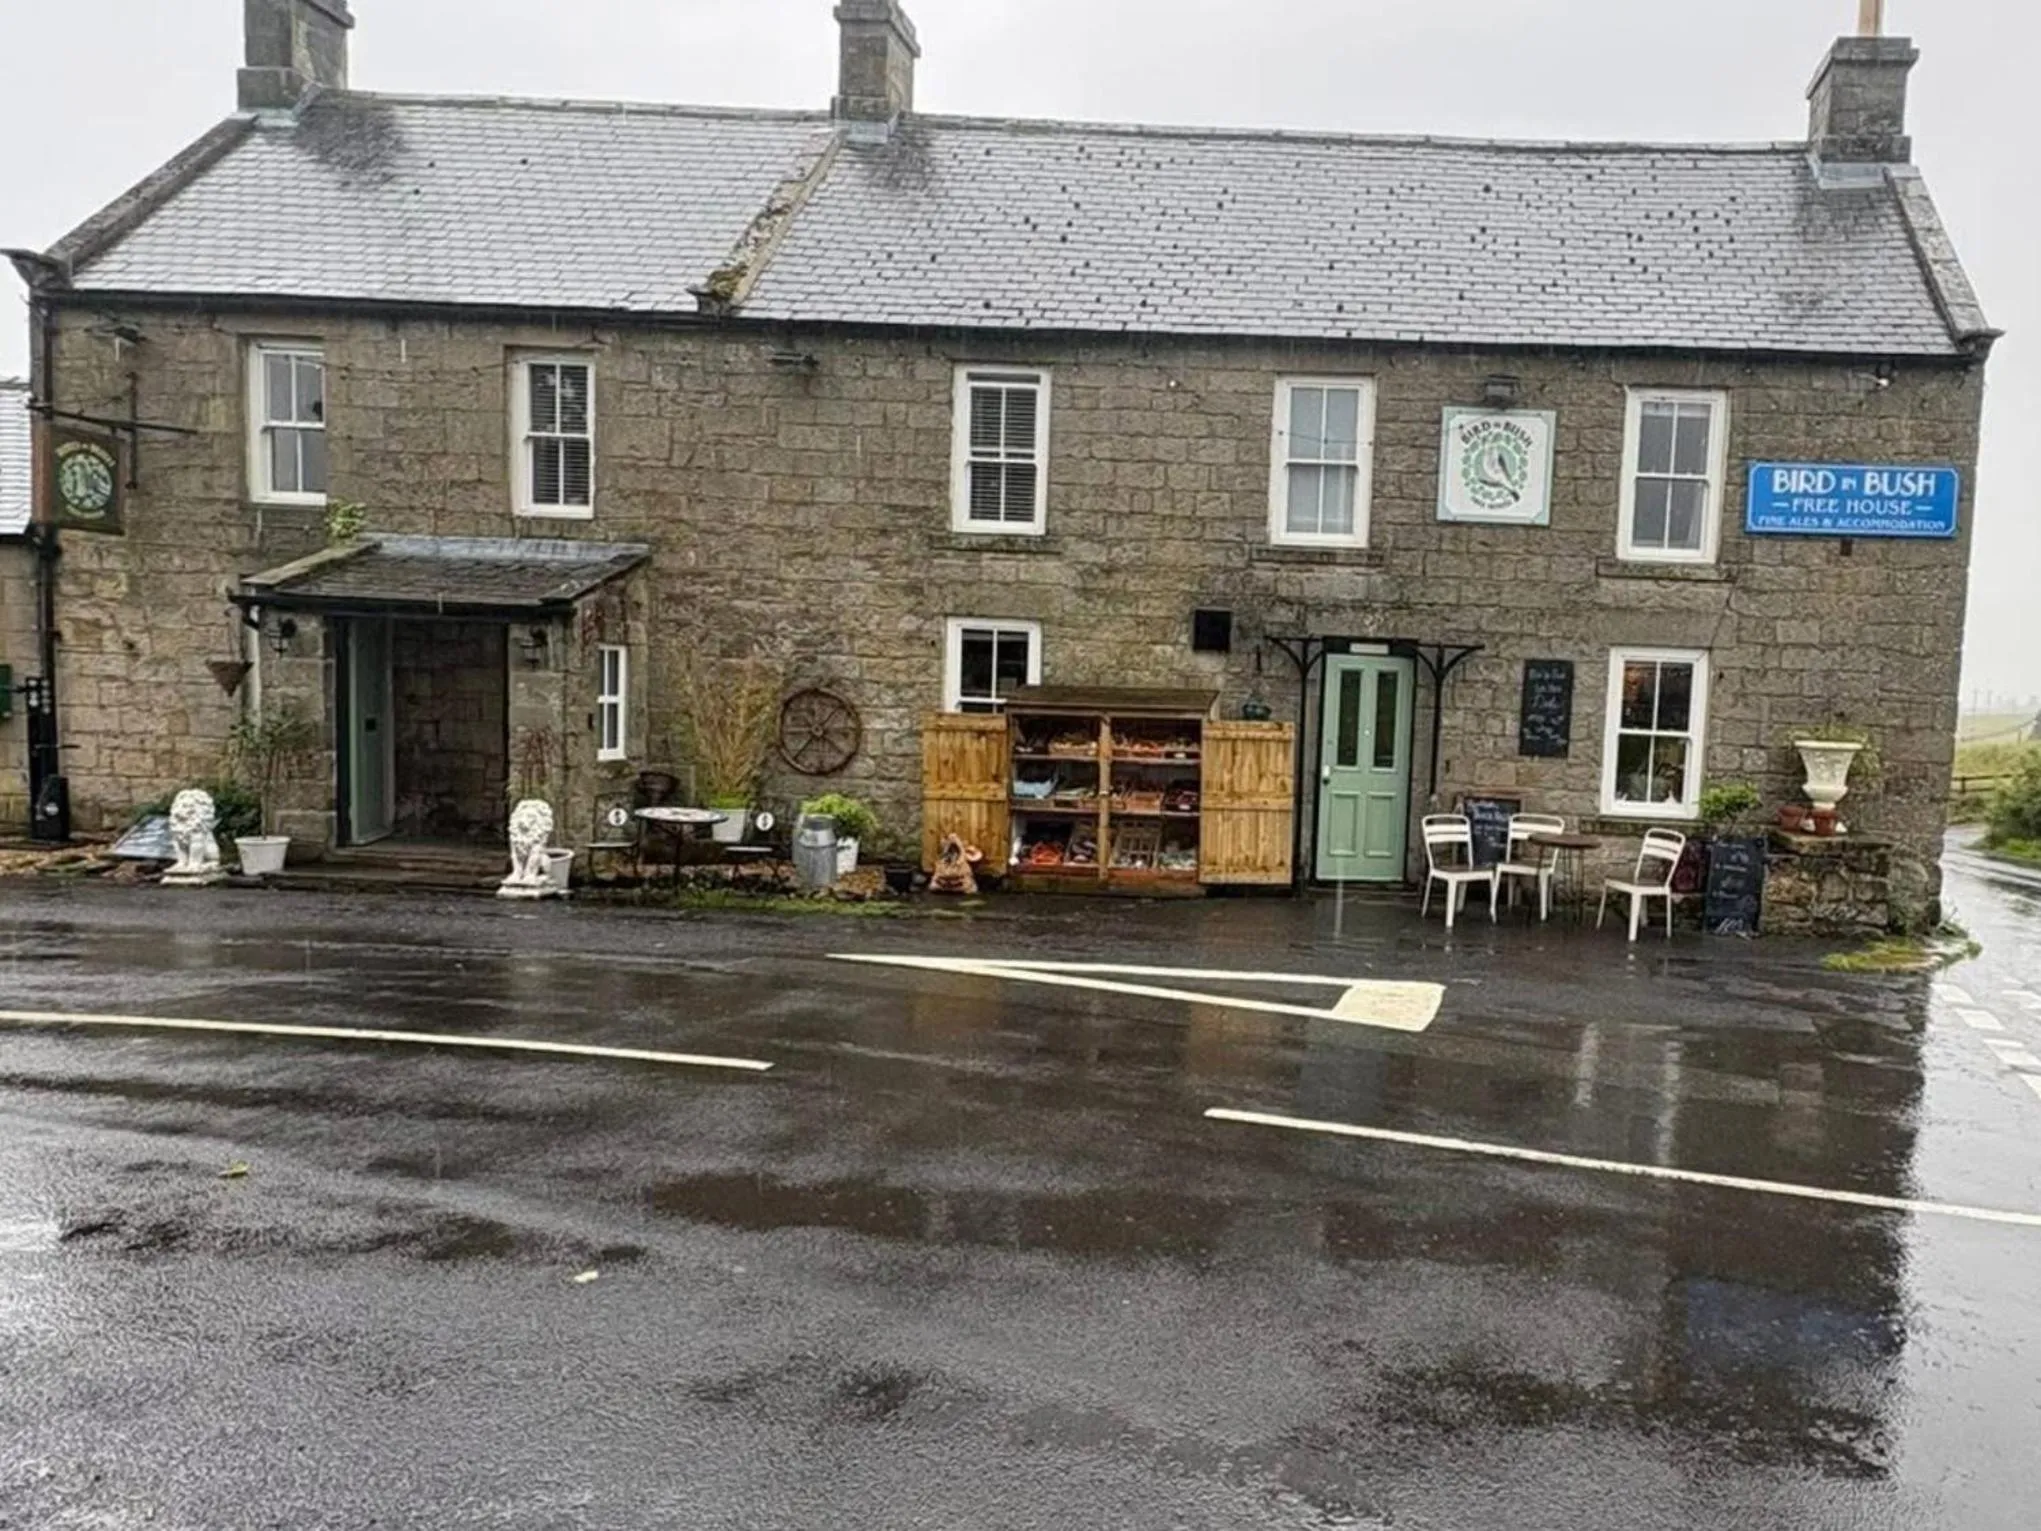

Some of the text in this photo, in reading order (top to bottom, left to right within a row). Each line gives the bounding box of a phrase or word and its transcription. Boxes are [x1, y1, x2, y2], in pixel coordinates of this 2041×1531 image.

[1461, 421, 1492, 445] BIRD
[1772, 469, 1836, 495] BIRD
[1864, 471, 1936, 497] BUSH
[1792, 498, 1913, 516] FREE HOUSE
[1790, 516, 1817, 527] ALES
[1836, 517, 1946, 530] ACCOMMODATION
